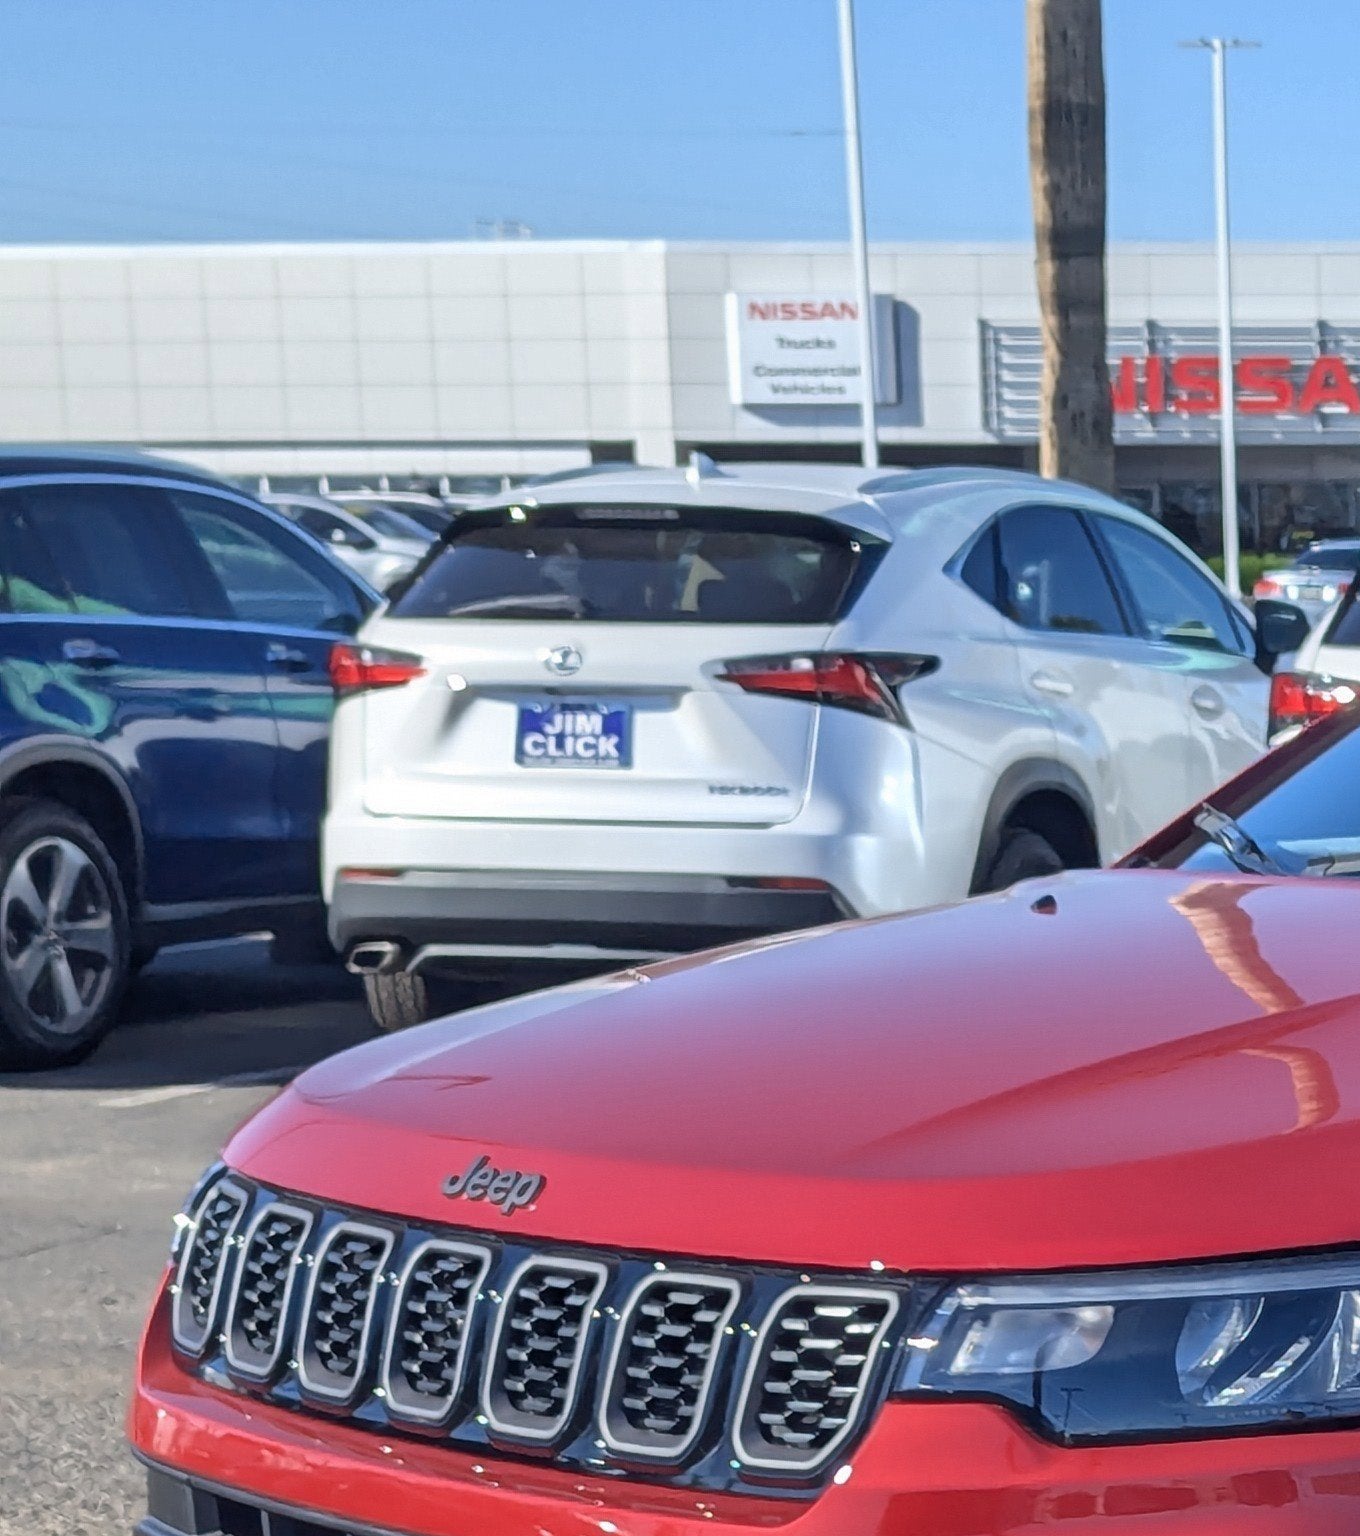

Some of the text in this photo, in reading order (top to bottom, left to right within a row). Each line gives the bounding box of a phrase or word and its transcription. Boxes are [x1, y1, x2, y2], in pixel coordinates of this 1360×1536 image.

[748, 300, 859, 321] NISSAN
[775, 335, 837, 350] Trucks
[752, 364, 861, 378] Commercial
[770, 383, 847, 395] Vehicles
[542, 712, 603, 735] JIM
[522, 733, 620, 758] CLICK
[441, 1155, 547, 1217] Jeep
